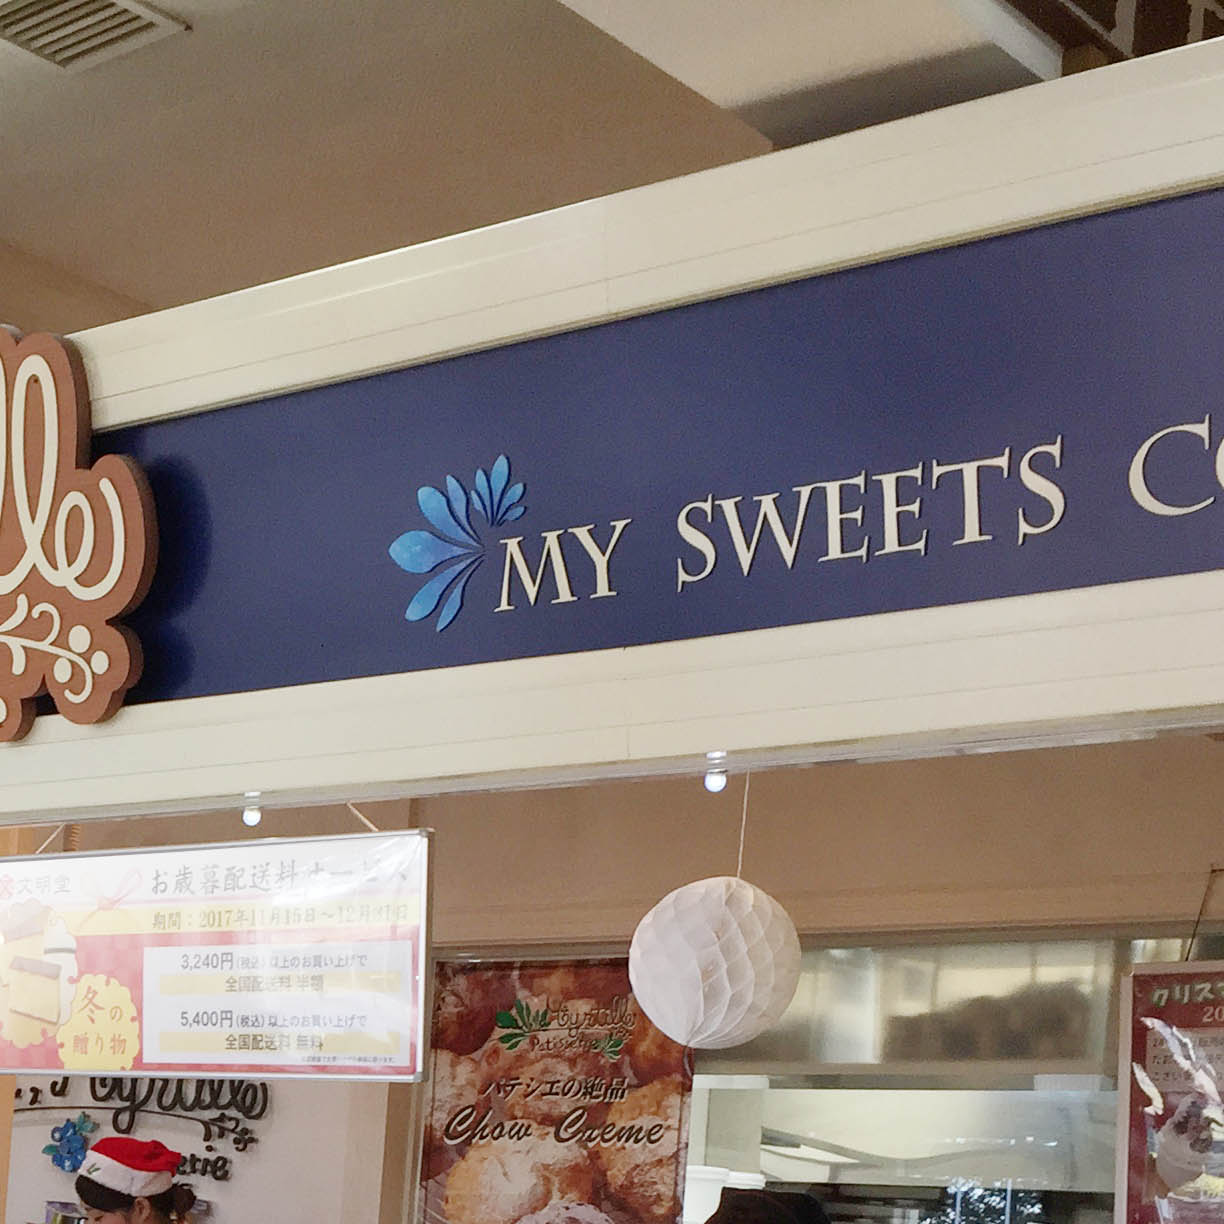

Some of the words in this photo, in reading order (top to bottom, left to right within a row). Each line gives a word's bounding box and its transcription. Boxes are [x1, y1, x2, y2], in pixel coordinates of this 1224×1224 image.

[494, 518, 632, 614] MY
[676, 433, 1068, 594] SWEETS
[77, 984, 124, 1026] 冬の
[72, 1031, 129, 1057] 贈り物
